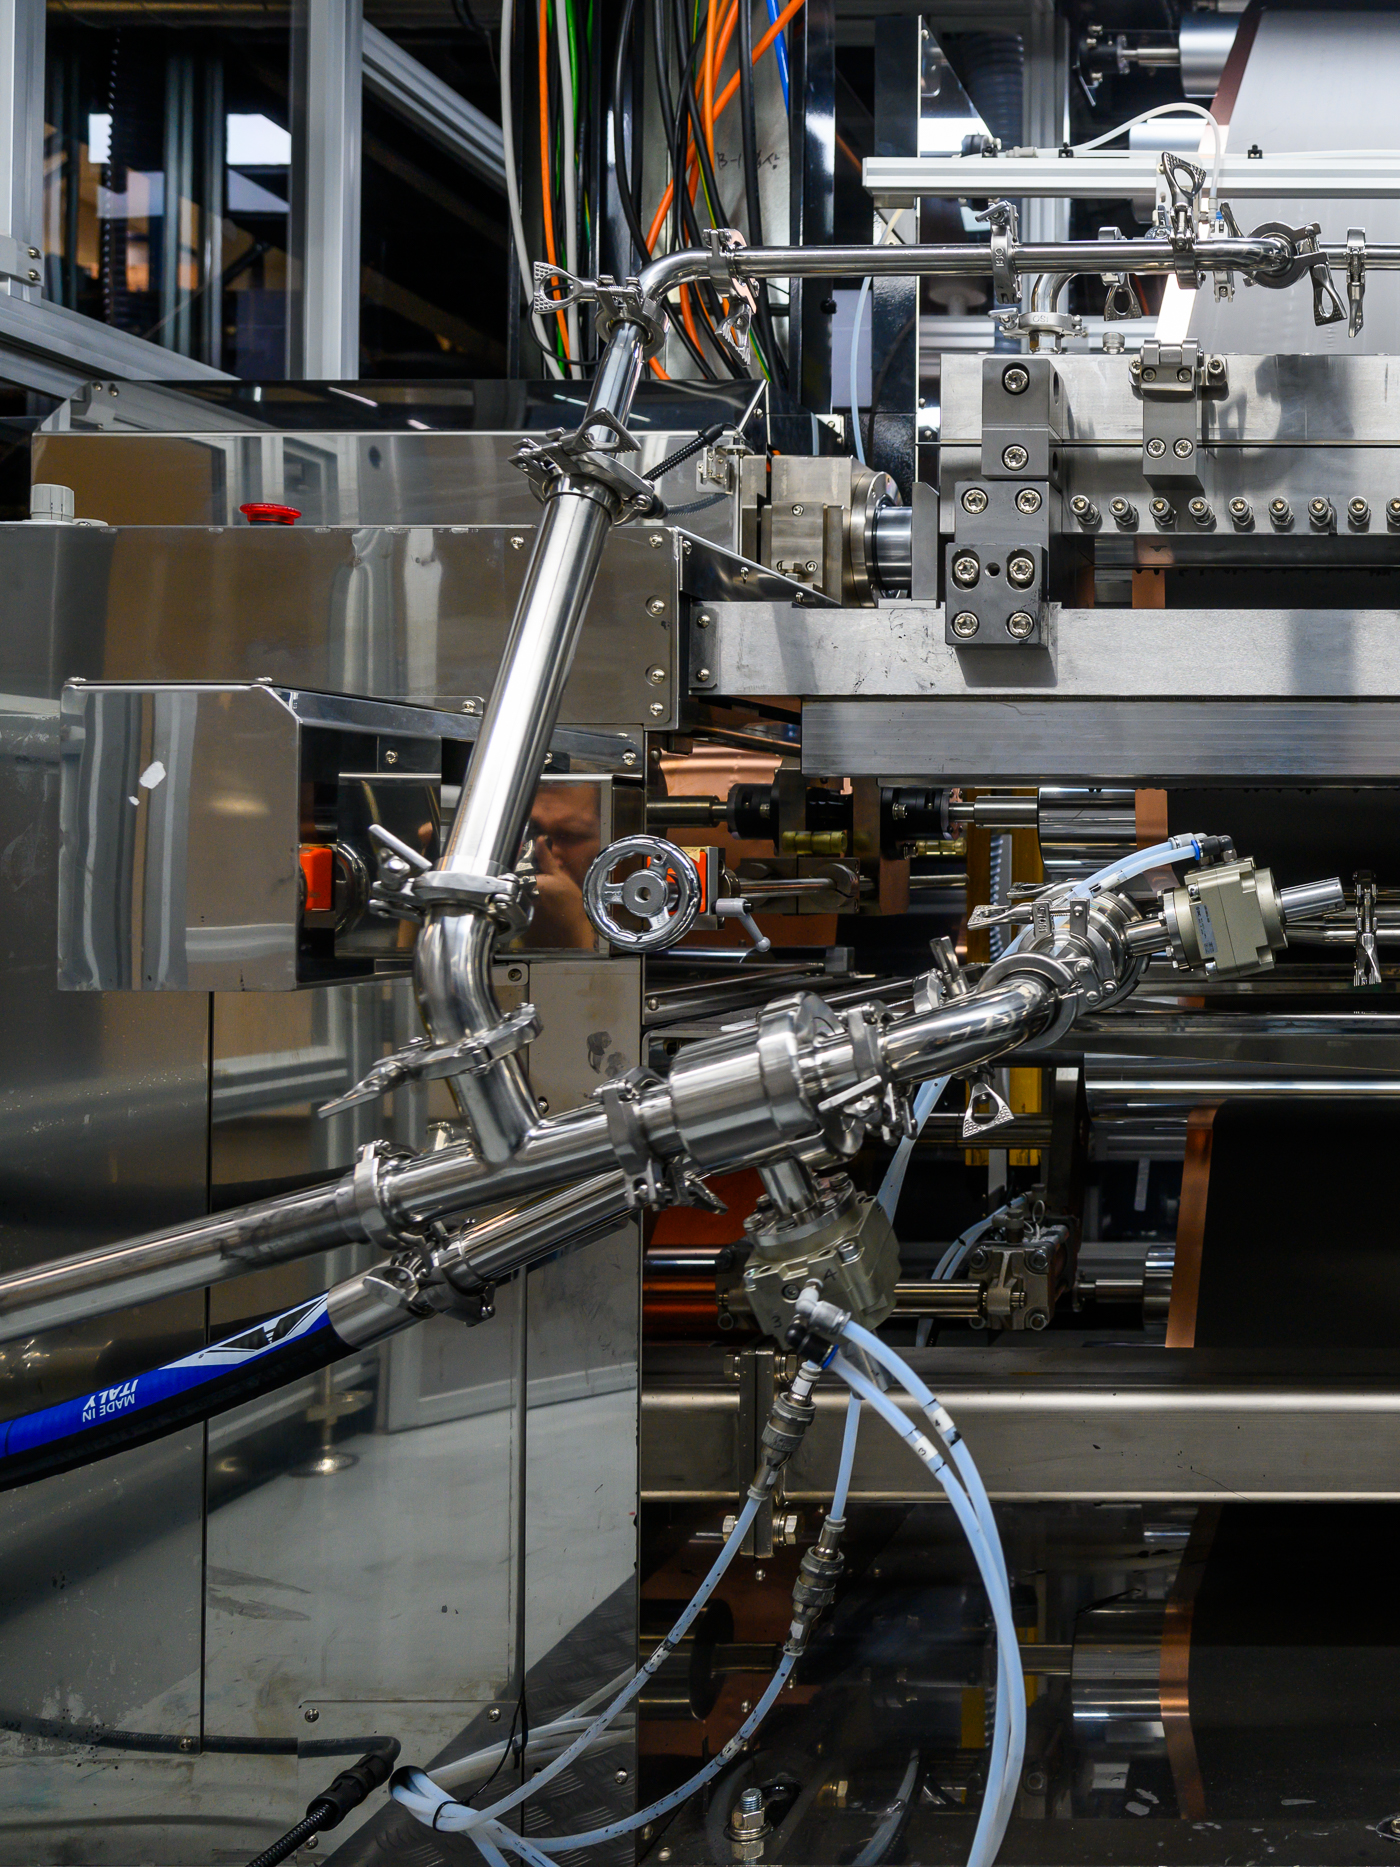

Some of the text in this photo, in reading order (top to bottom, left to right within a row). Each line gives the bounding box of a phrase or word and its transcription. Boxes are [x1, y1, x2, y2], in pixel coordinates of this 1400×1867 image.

[82, 1393, 136, 1423] MADE IN
[83, 1379, 139, 1411] ITALY
[918, 1447, 927, 1456] 3
